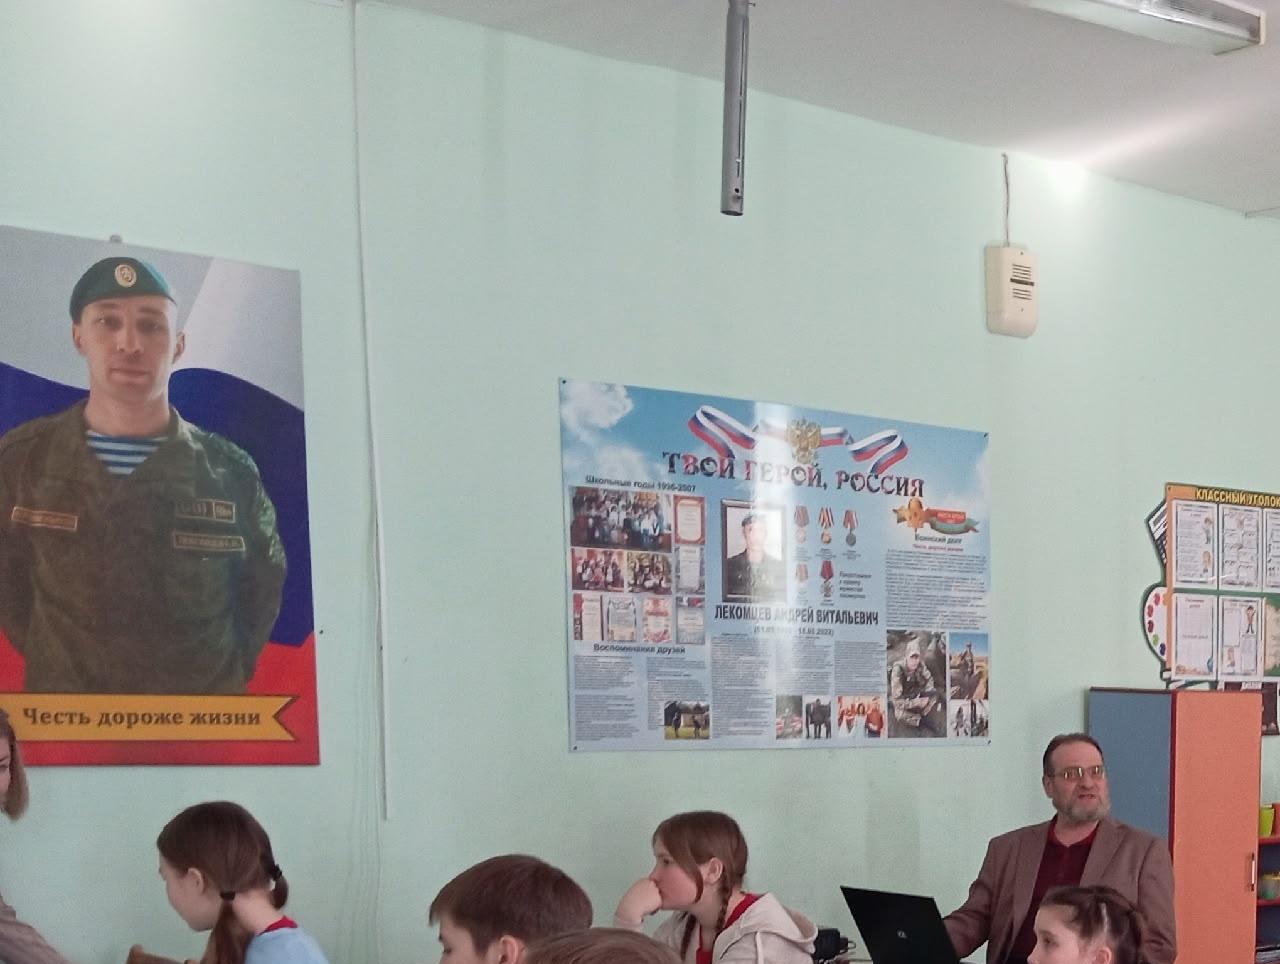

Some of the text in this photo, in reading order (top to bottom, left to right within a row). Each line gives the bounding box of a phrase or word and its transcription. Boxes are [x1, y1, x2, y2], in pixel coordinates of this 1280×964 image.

[662, 452, 736, 479] ТВОЙ
[835, 470, 924, 497] РОССИЯ
[1195, 488, 1247, 505] КЛАССНЫЙ
[816, 609, 879, 625] ВИТАЛЬЕВИЧ
[22, 708, 261, 729] Честь дороже жизни
